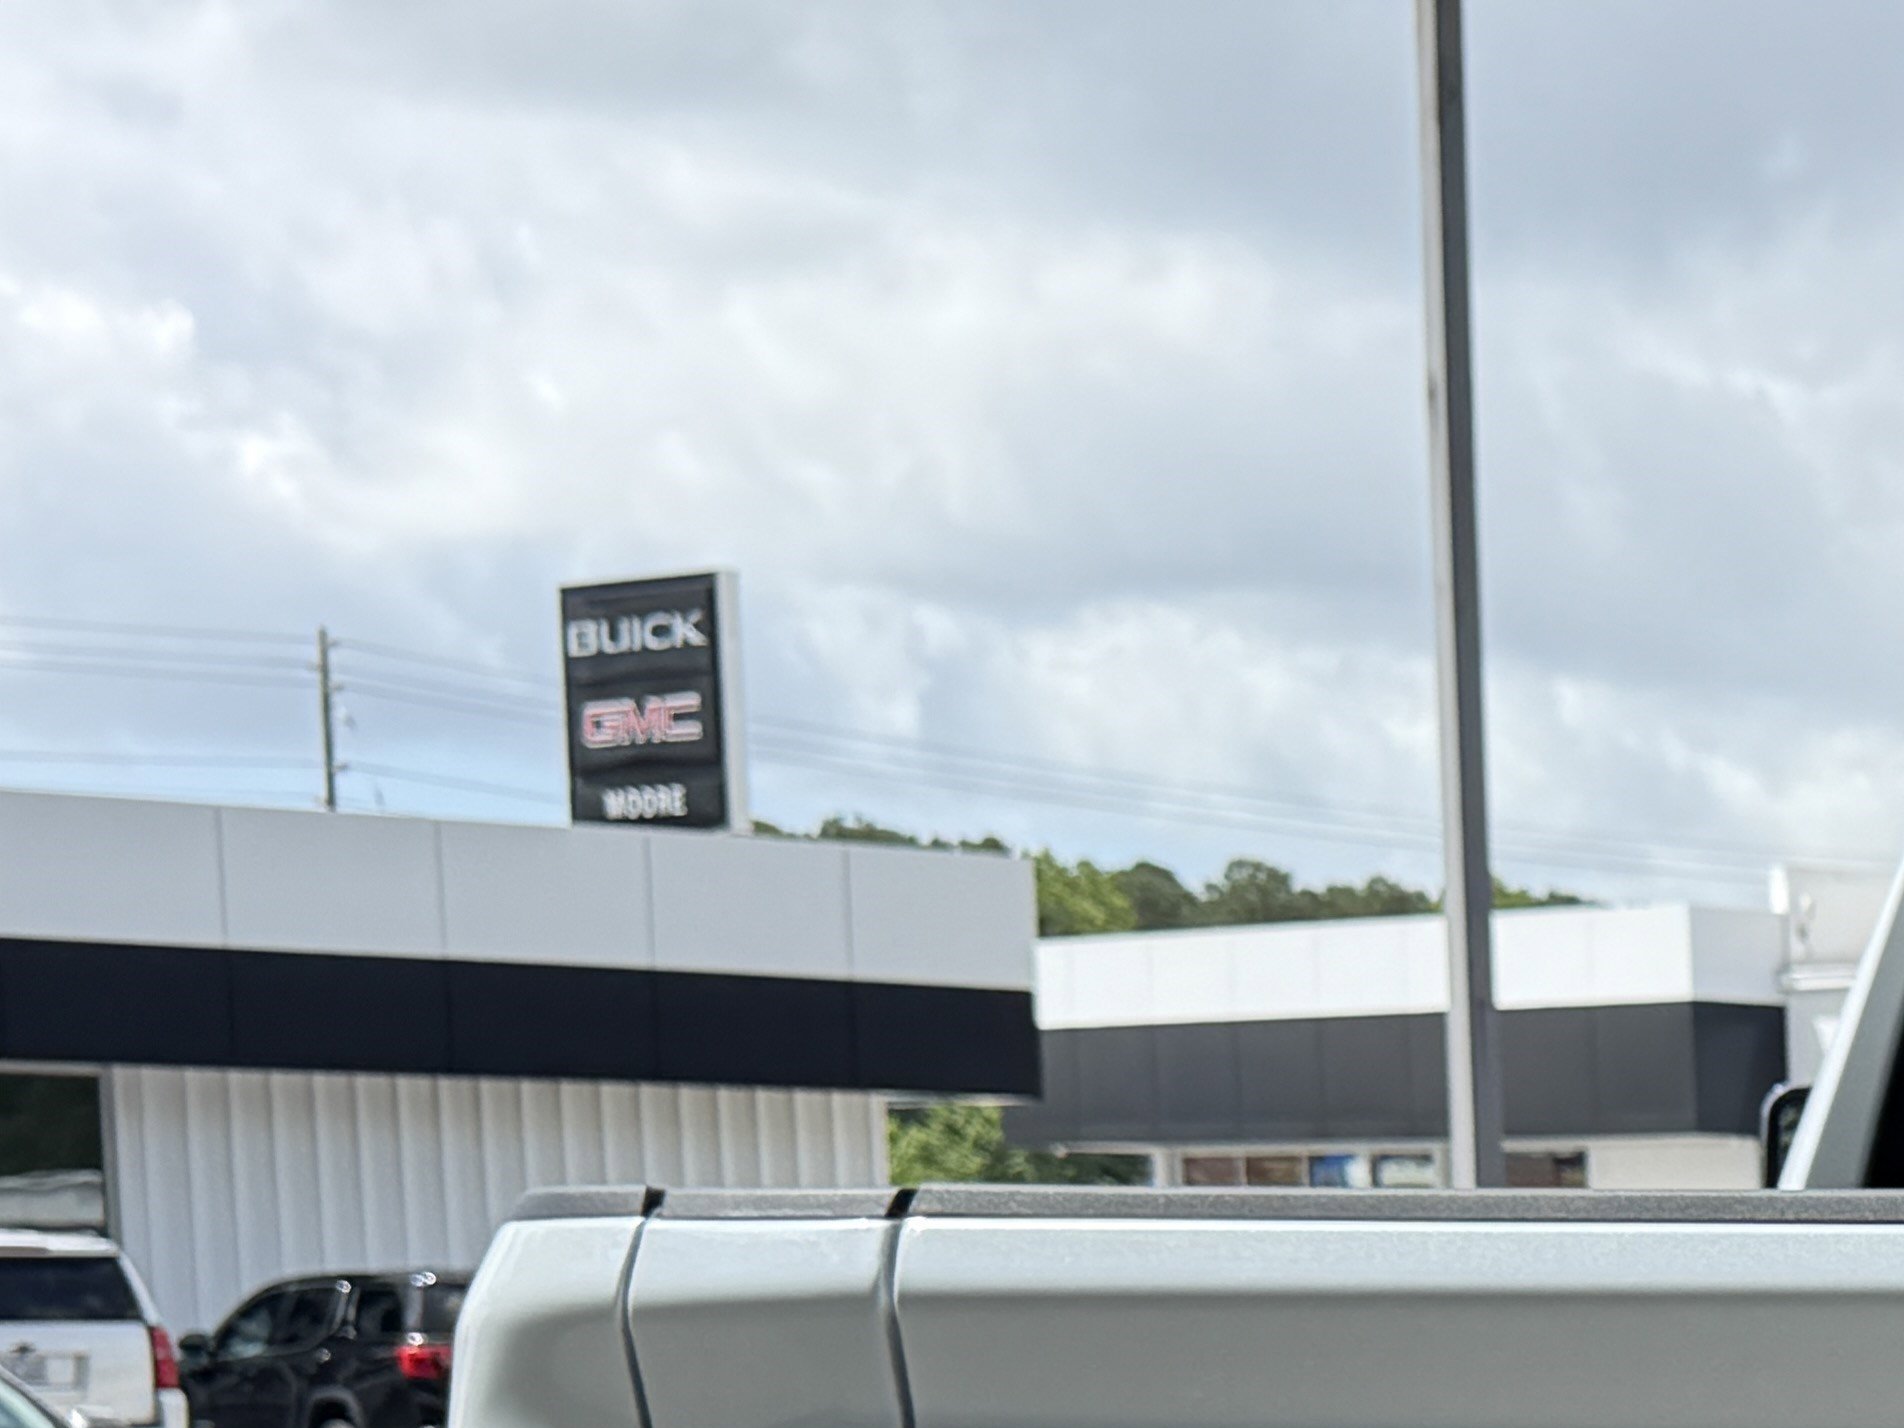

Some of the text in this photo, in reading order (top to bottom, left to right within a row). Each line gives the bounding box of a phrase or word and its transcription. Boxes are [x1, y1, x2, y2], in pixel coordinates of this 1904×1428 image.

[567, 608, 709, 658] BUICK
[582, 690, 703, 749] GMC
[603, 782, 688, 821] MOORE
